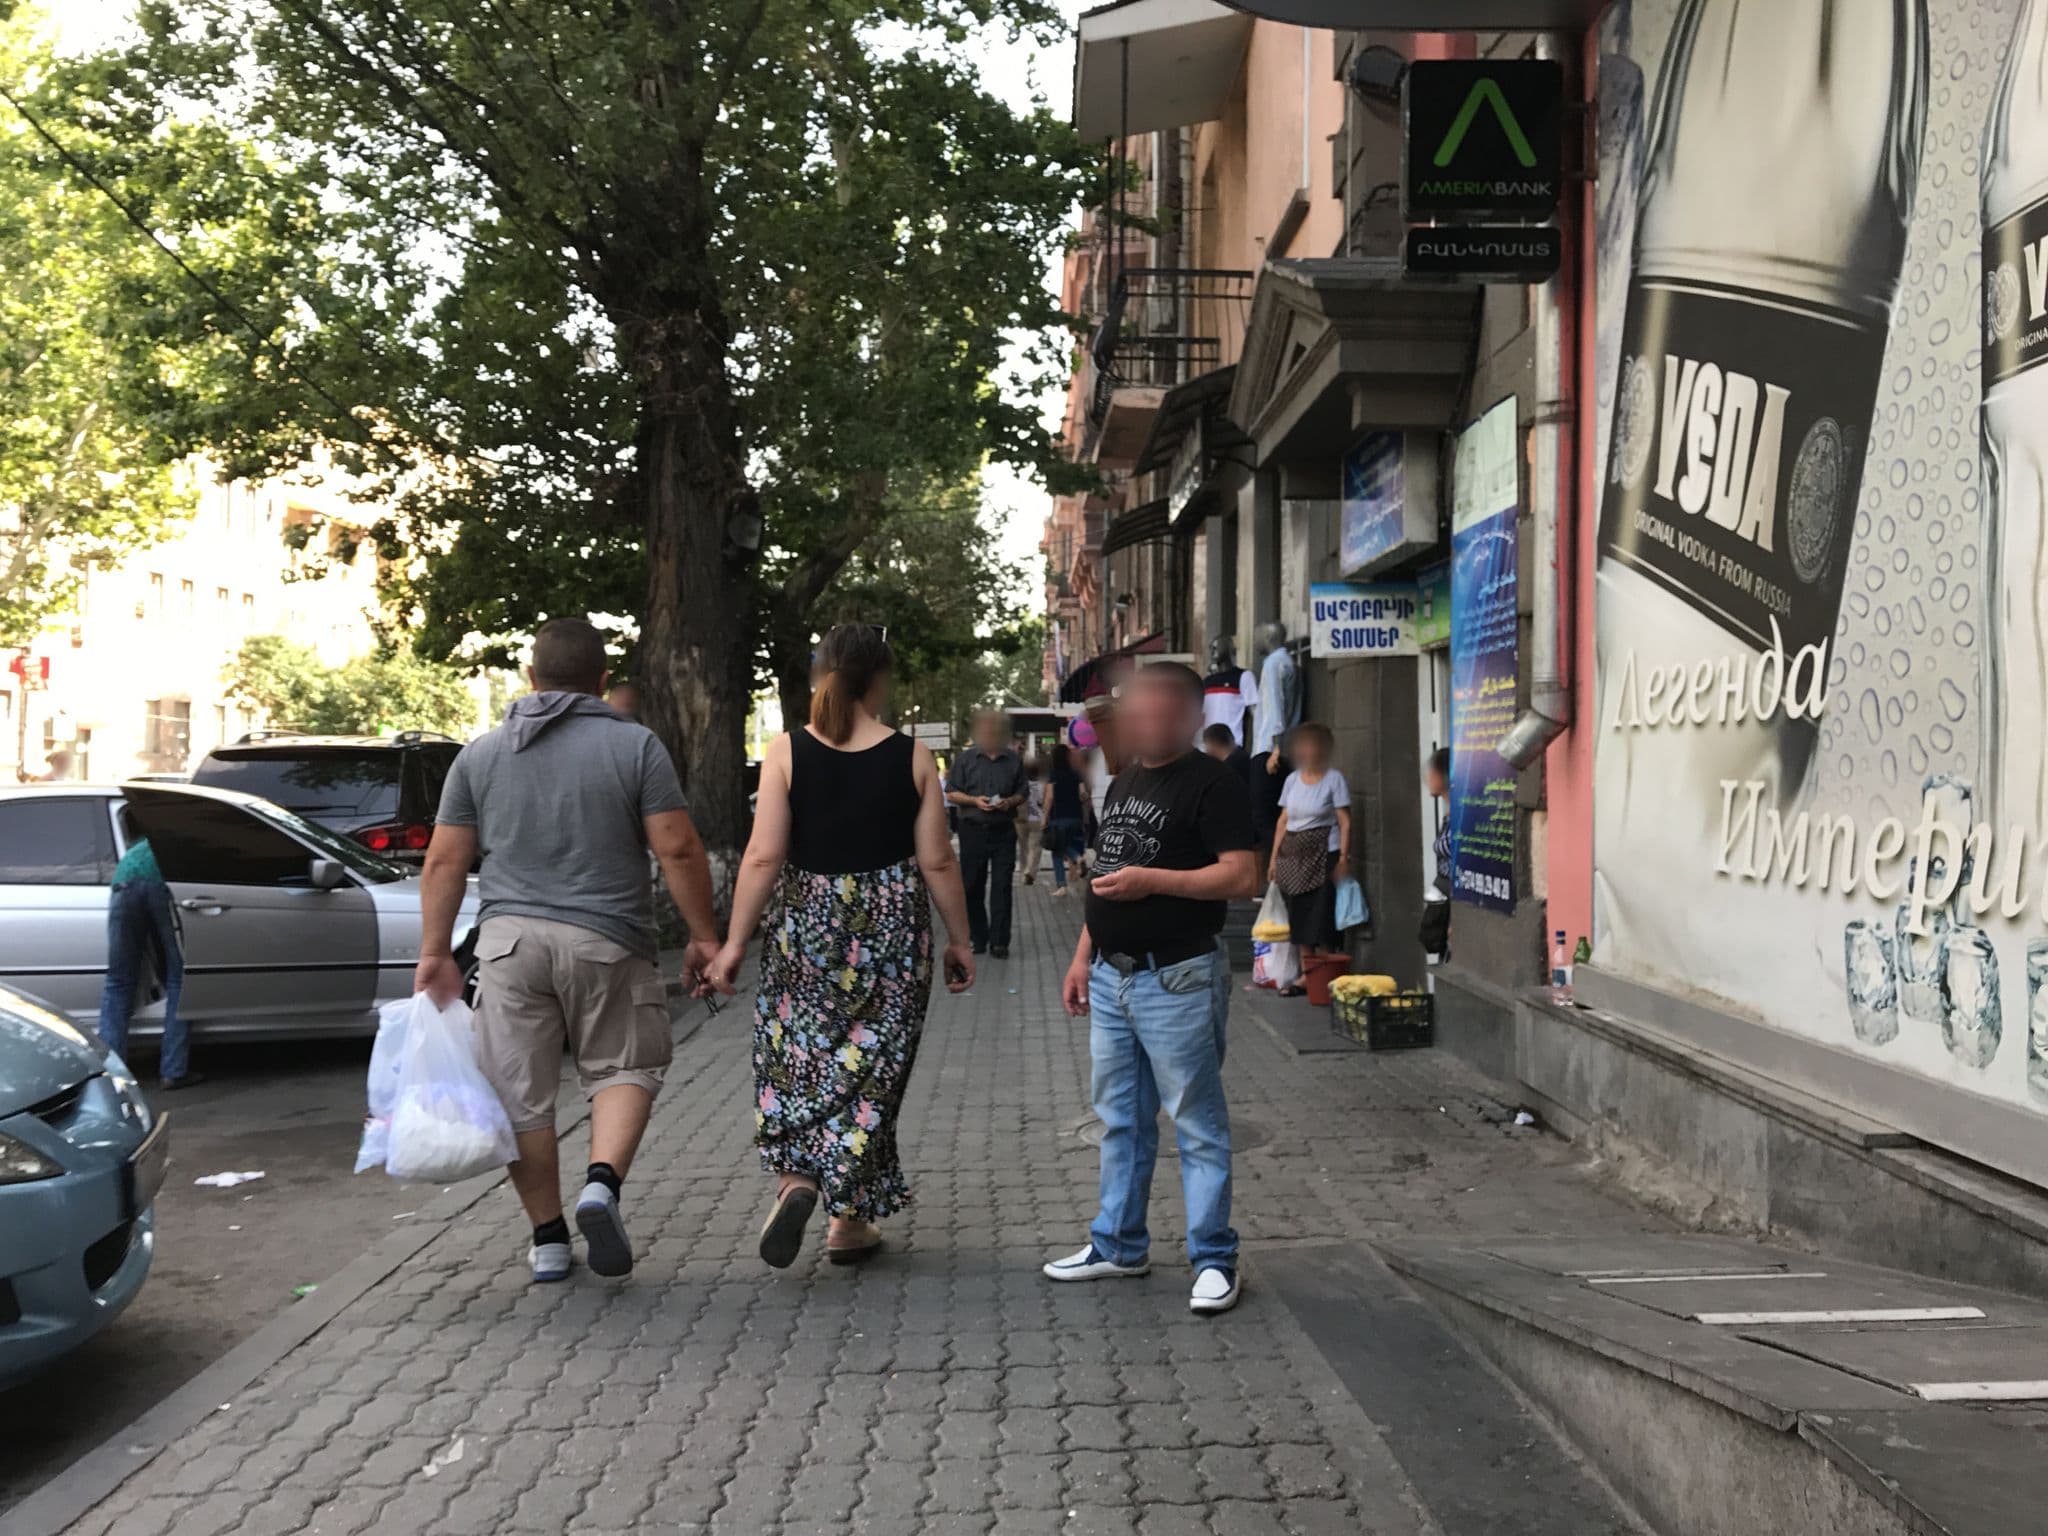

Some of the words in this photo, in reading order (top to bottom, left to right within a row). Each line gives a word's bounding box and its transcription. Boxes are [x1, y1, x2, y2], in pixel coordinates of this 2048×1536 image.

[1418, 181, 1551, 196] AMERIABANK
[1417, 242, 1550, 256] ԲԱՆԿՈՄԱՏ
[1634, 509, 1675, 549] ORIGINAL
[1678, 531, 1716, 573] VODKA
[1718, 555, 1753, 593] FROM
[1754, 576, 1792, 618] RUSSIA
[1331, 627, 1399, 649] ՏՈՄՍԵՐ
[1612, 613, 1830, 729] Легенда
[1713, 778, 2048, 937] Импери
